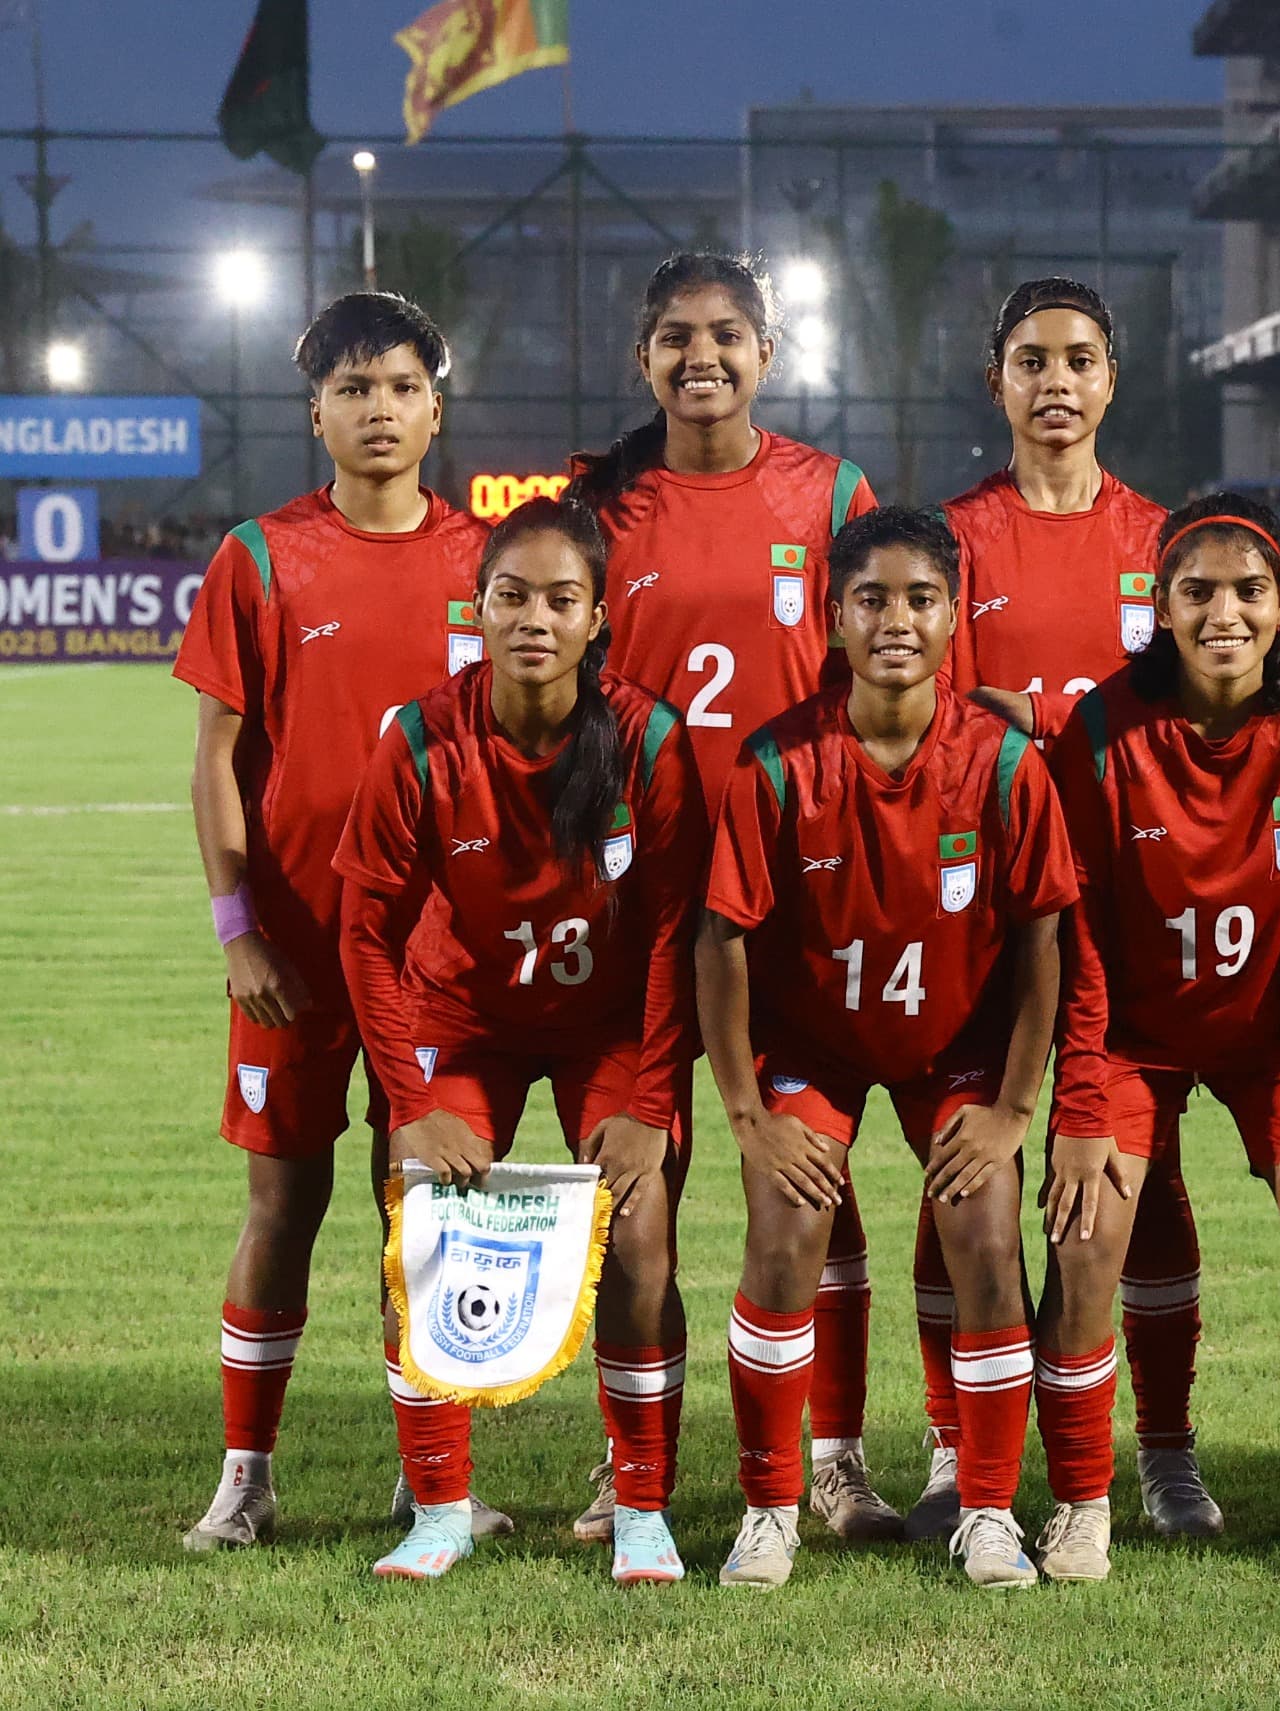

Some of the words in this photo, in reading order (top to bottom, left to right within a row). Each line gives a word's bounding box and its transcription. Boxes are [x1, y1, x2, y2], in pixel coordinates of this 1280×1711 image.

[0, 418, 188, 454] NGLADESH
[33, 494, 83, 562] 0
[0, 574, 162, 625] MEN'S
[686, 643, 735, 728] 2
[504, 918, 593, 985] 13
[1165, 905, 1255, 980] 19
[832, 939, 925, 1015] 14
[432, 1182, 559, 1214] BAGLADESH
[487, 1215, 557, 1232] FEDERATION
